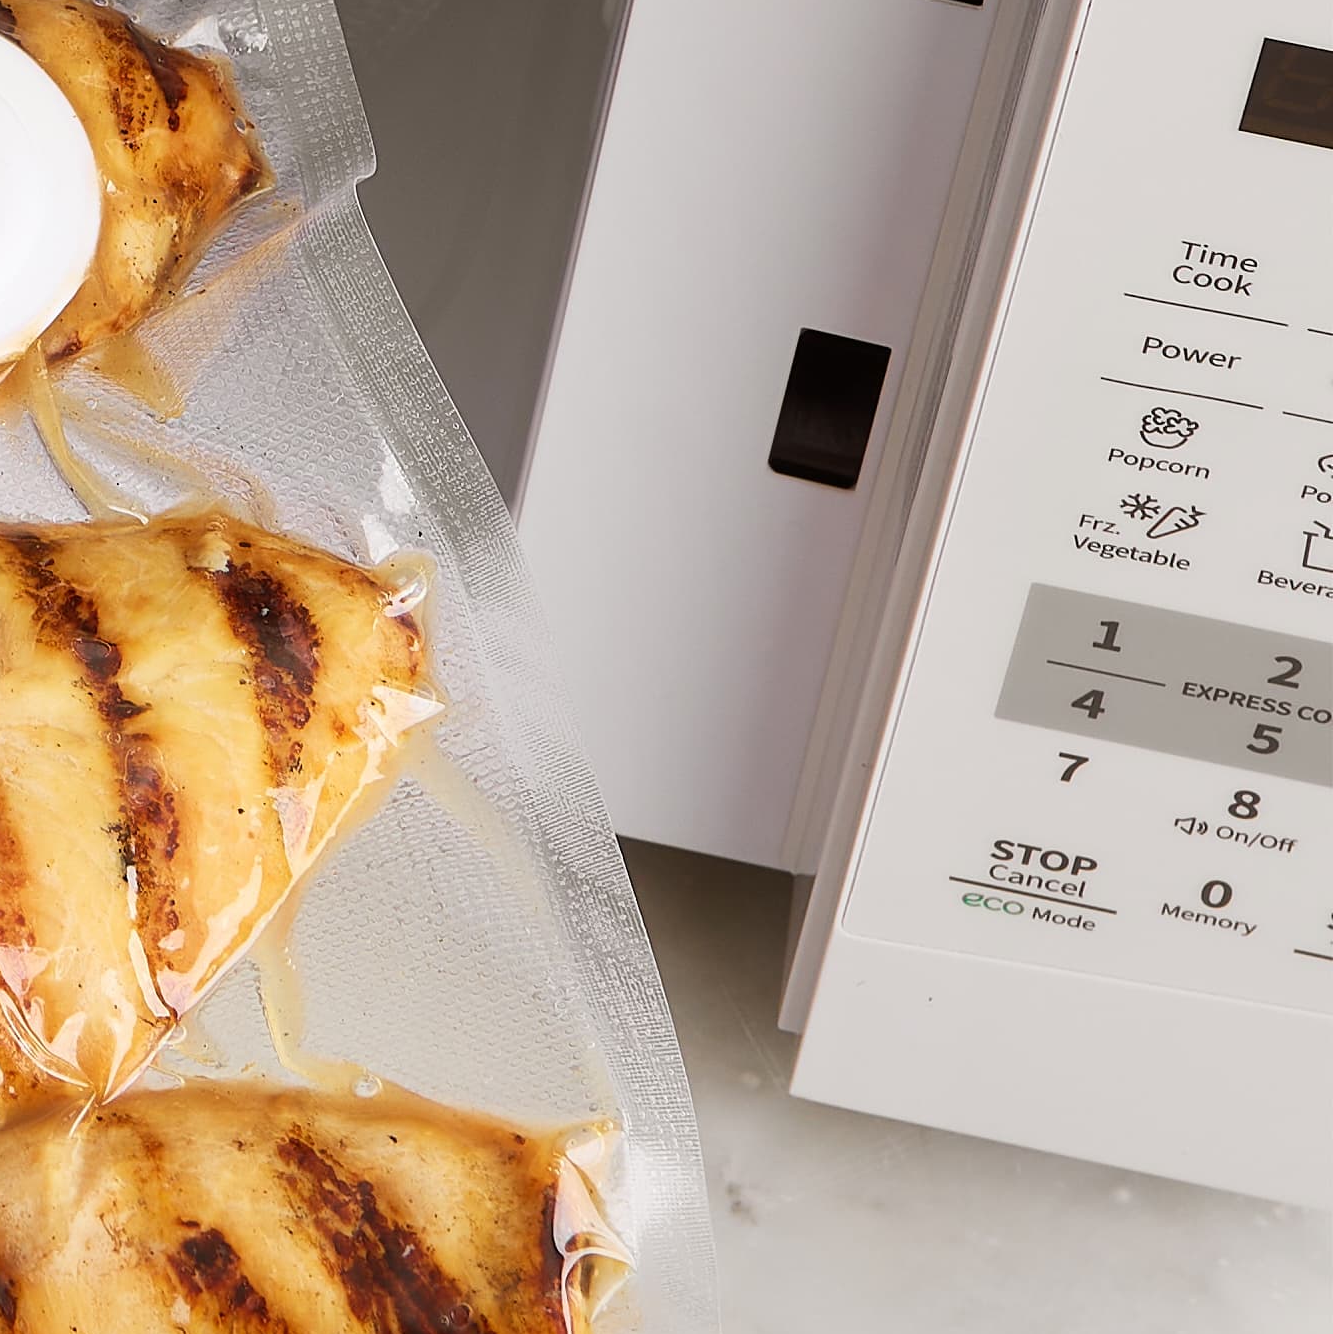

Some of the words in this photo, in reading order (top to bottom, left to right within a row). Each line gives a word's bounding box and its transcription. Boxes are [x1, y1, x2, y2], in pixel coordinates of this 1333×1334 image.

[1182, 241, 1258, 272] Time
[1172, 265, 1253, 297] Cook
[1141, 336, 1242, 369] Power
[1107, 447, 1211, 480] Popcorn
[1300, 484, 1333, 504] Po
[1078, 513, 1121, 535] Frz.
[1073, 534, 1191, 571] Vegetable
[1092, 621, 1122, 652] 1
[1266, 655, 1304, 689] 2
[1070, 689, 1106, 719] 4
[1182, 682, 1292, 716] EXPRESS
[1296, 705, 1333, 725] CO
[1246, 723, 1284, 755] 5
[1057, 752, 1090, 783] 7
[1227, 789, 1262, 820] 8
[1216, 826, 1298, 853] On/Off
[990, 840, 1098, 876] STOP
[988, 864, 1087, 898] Cancel
[1199, 879, 1234, 909] 0
[961, 892, 1025, 916] eco
[1031, 906, 1097, 932] Mode
[1160, 902, 1258, 937] Memory
